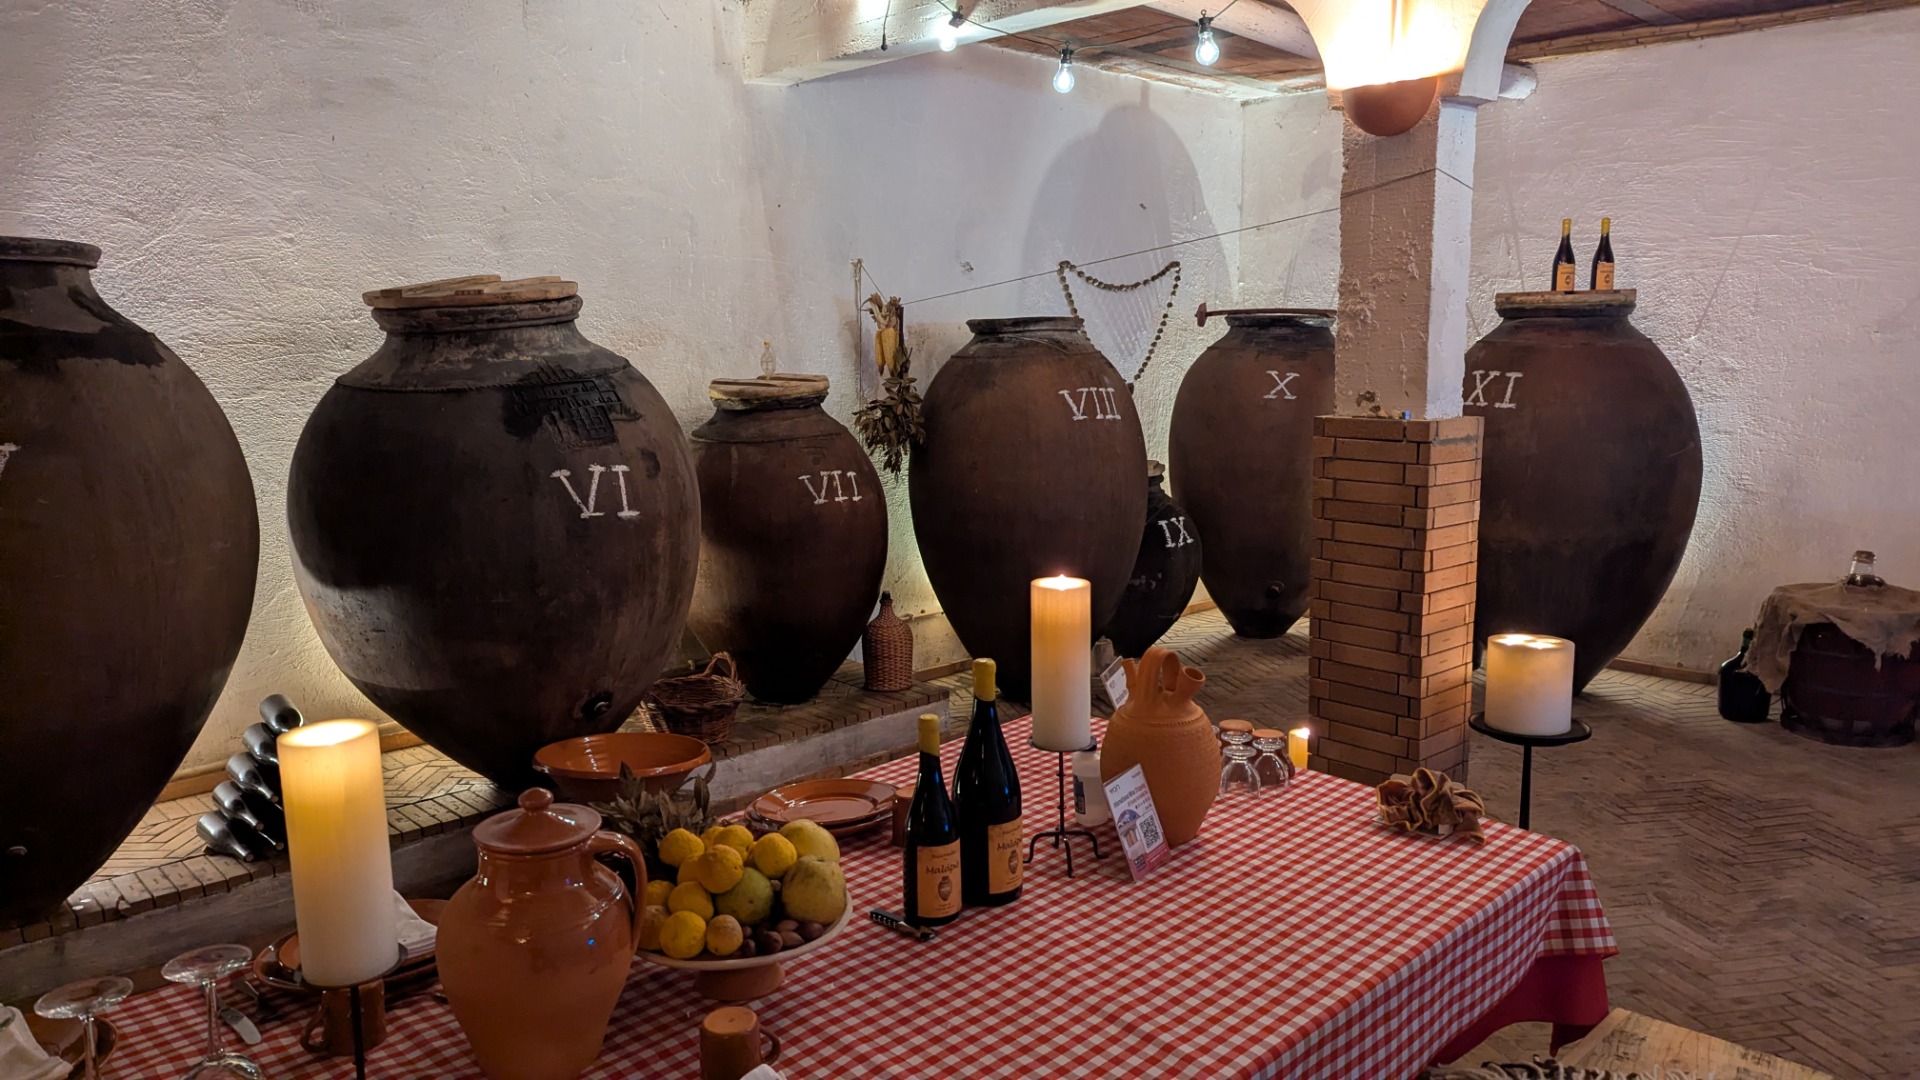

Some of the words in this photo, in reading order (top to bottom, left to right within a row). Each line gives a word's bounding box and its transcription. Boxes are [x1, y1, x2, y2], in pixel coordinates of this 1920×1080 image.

[1263, 371, 1300, 400] X
[1464, 370, 1524, 409] XI
[1058, 386, 1122, 421] VIII
[551, 463, 641, 519] VI
[798, 469, 863, 505] VII
[1157, 515, 1195, 548] IX
